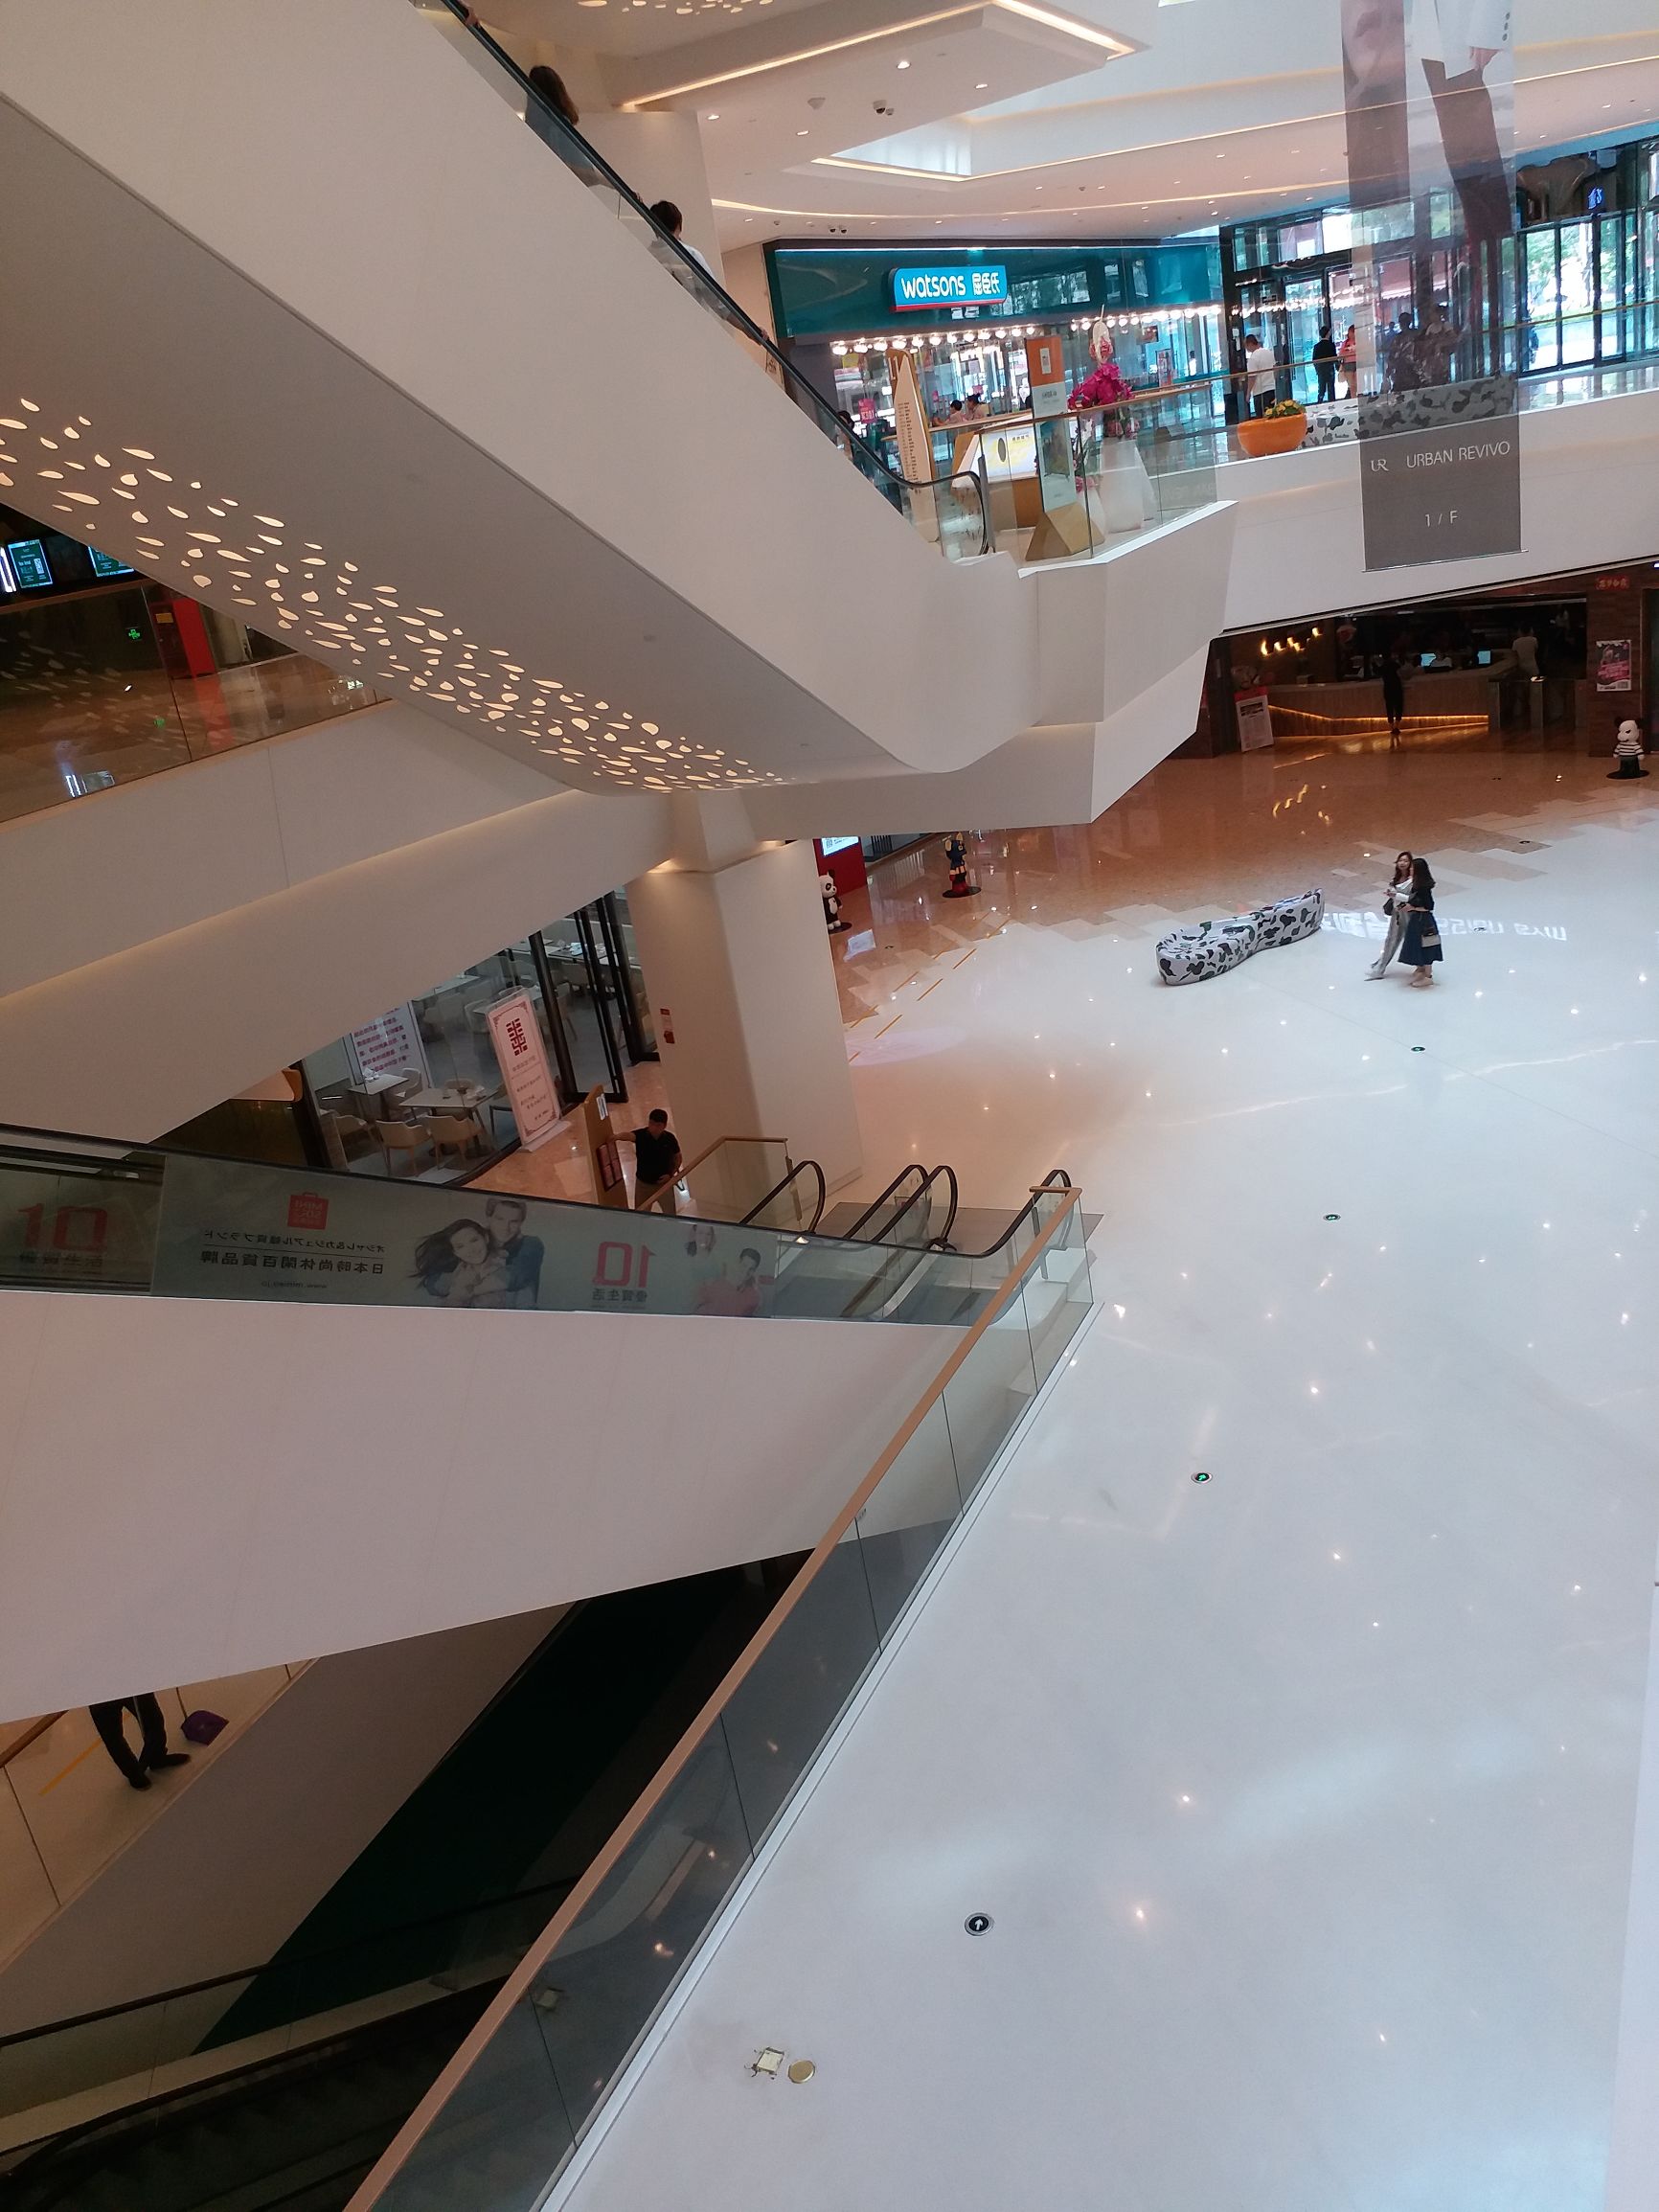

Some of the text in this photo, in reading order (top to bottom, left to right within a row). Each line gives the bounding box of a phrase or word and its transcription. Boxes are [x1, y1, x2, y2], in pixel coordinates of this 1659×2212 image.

[900, 273, 966, 299] watsons
[971, 272, 1001, 296] 屈臣氏
[1370, 441, 1511, 472] UR URBAN REVIVO
